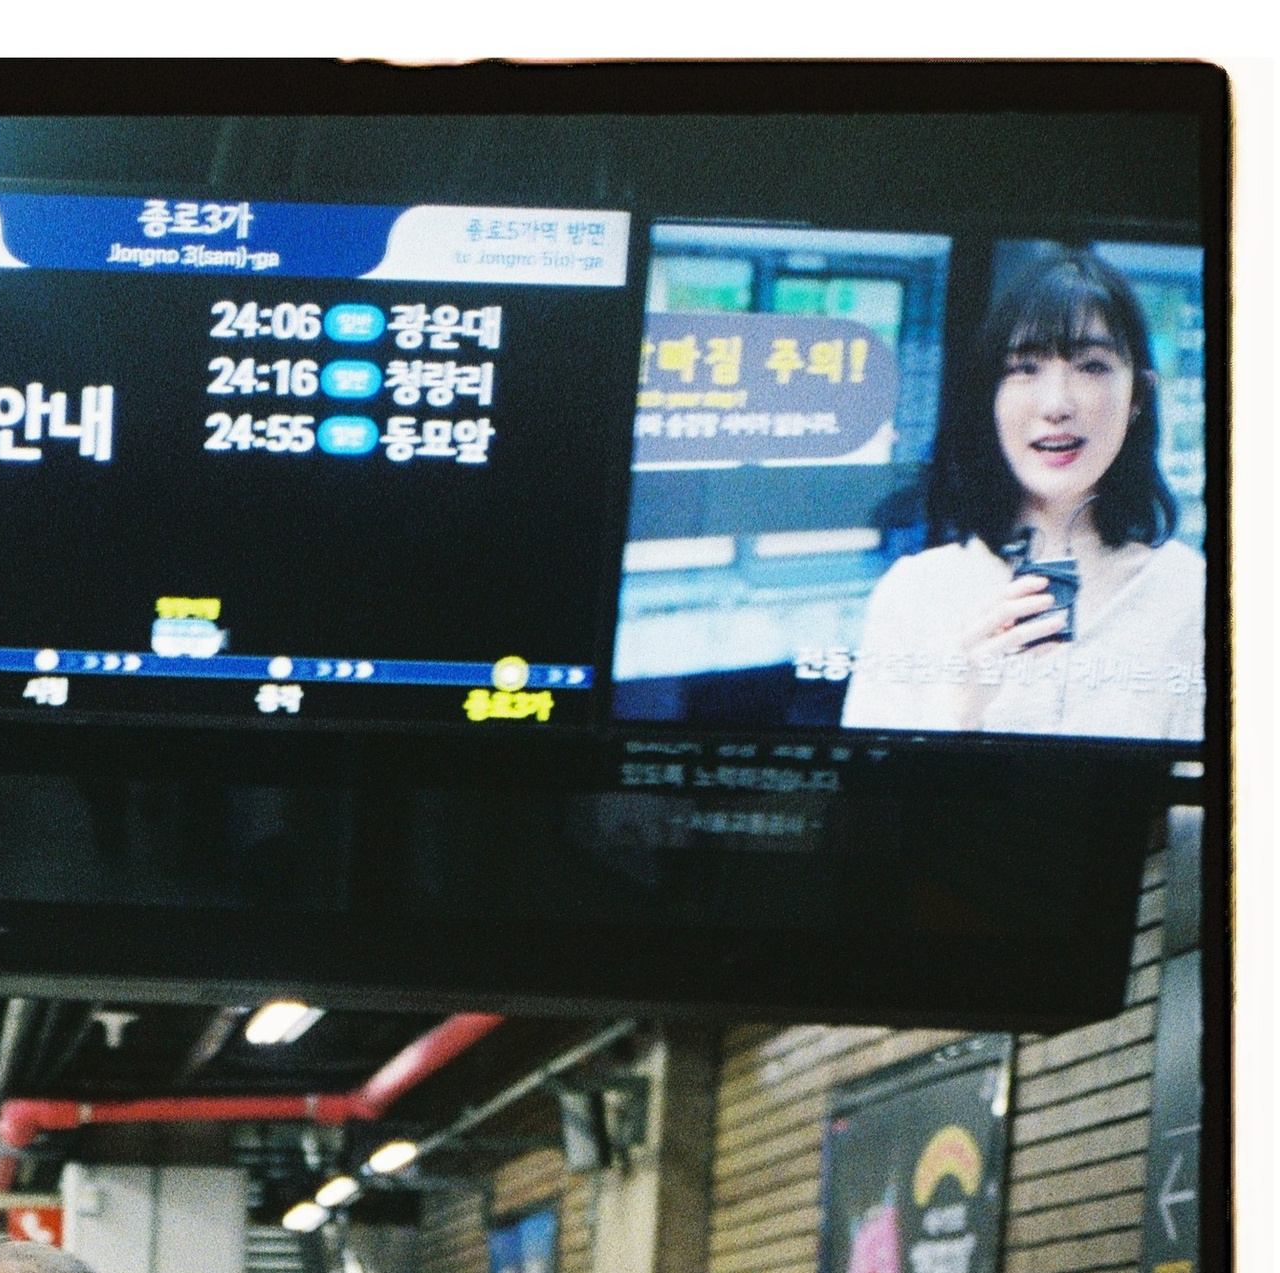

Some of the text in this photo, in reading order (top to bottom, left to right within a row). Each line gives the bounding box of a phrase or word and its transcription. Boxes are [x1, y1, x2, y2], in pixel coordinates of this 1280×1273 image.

[136, 200, 254, 239] 종로3가
[567, 220, 606, 246] 방면
[106, 243, 179, 267] Jongno
[209, 300, 321, 340] 24:06
[386, 303, 503, 350] 광운대
[206, 356, 319, 397] 24:16
[384, 360, 495, 407] 청량리
[203, 412, 316, 453] 24:55
[378, 416, 496, 463] 동묘앞
